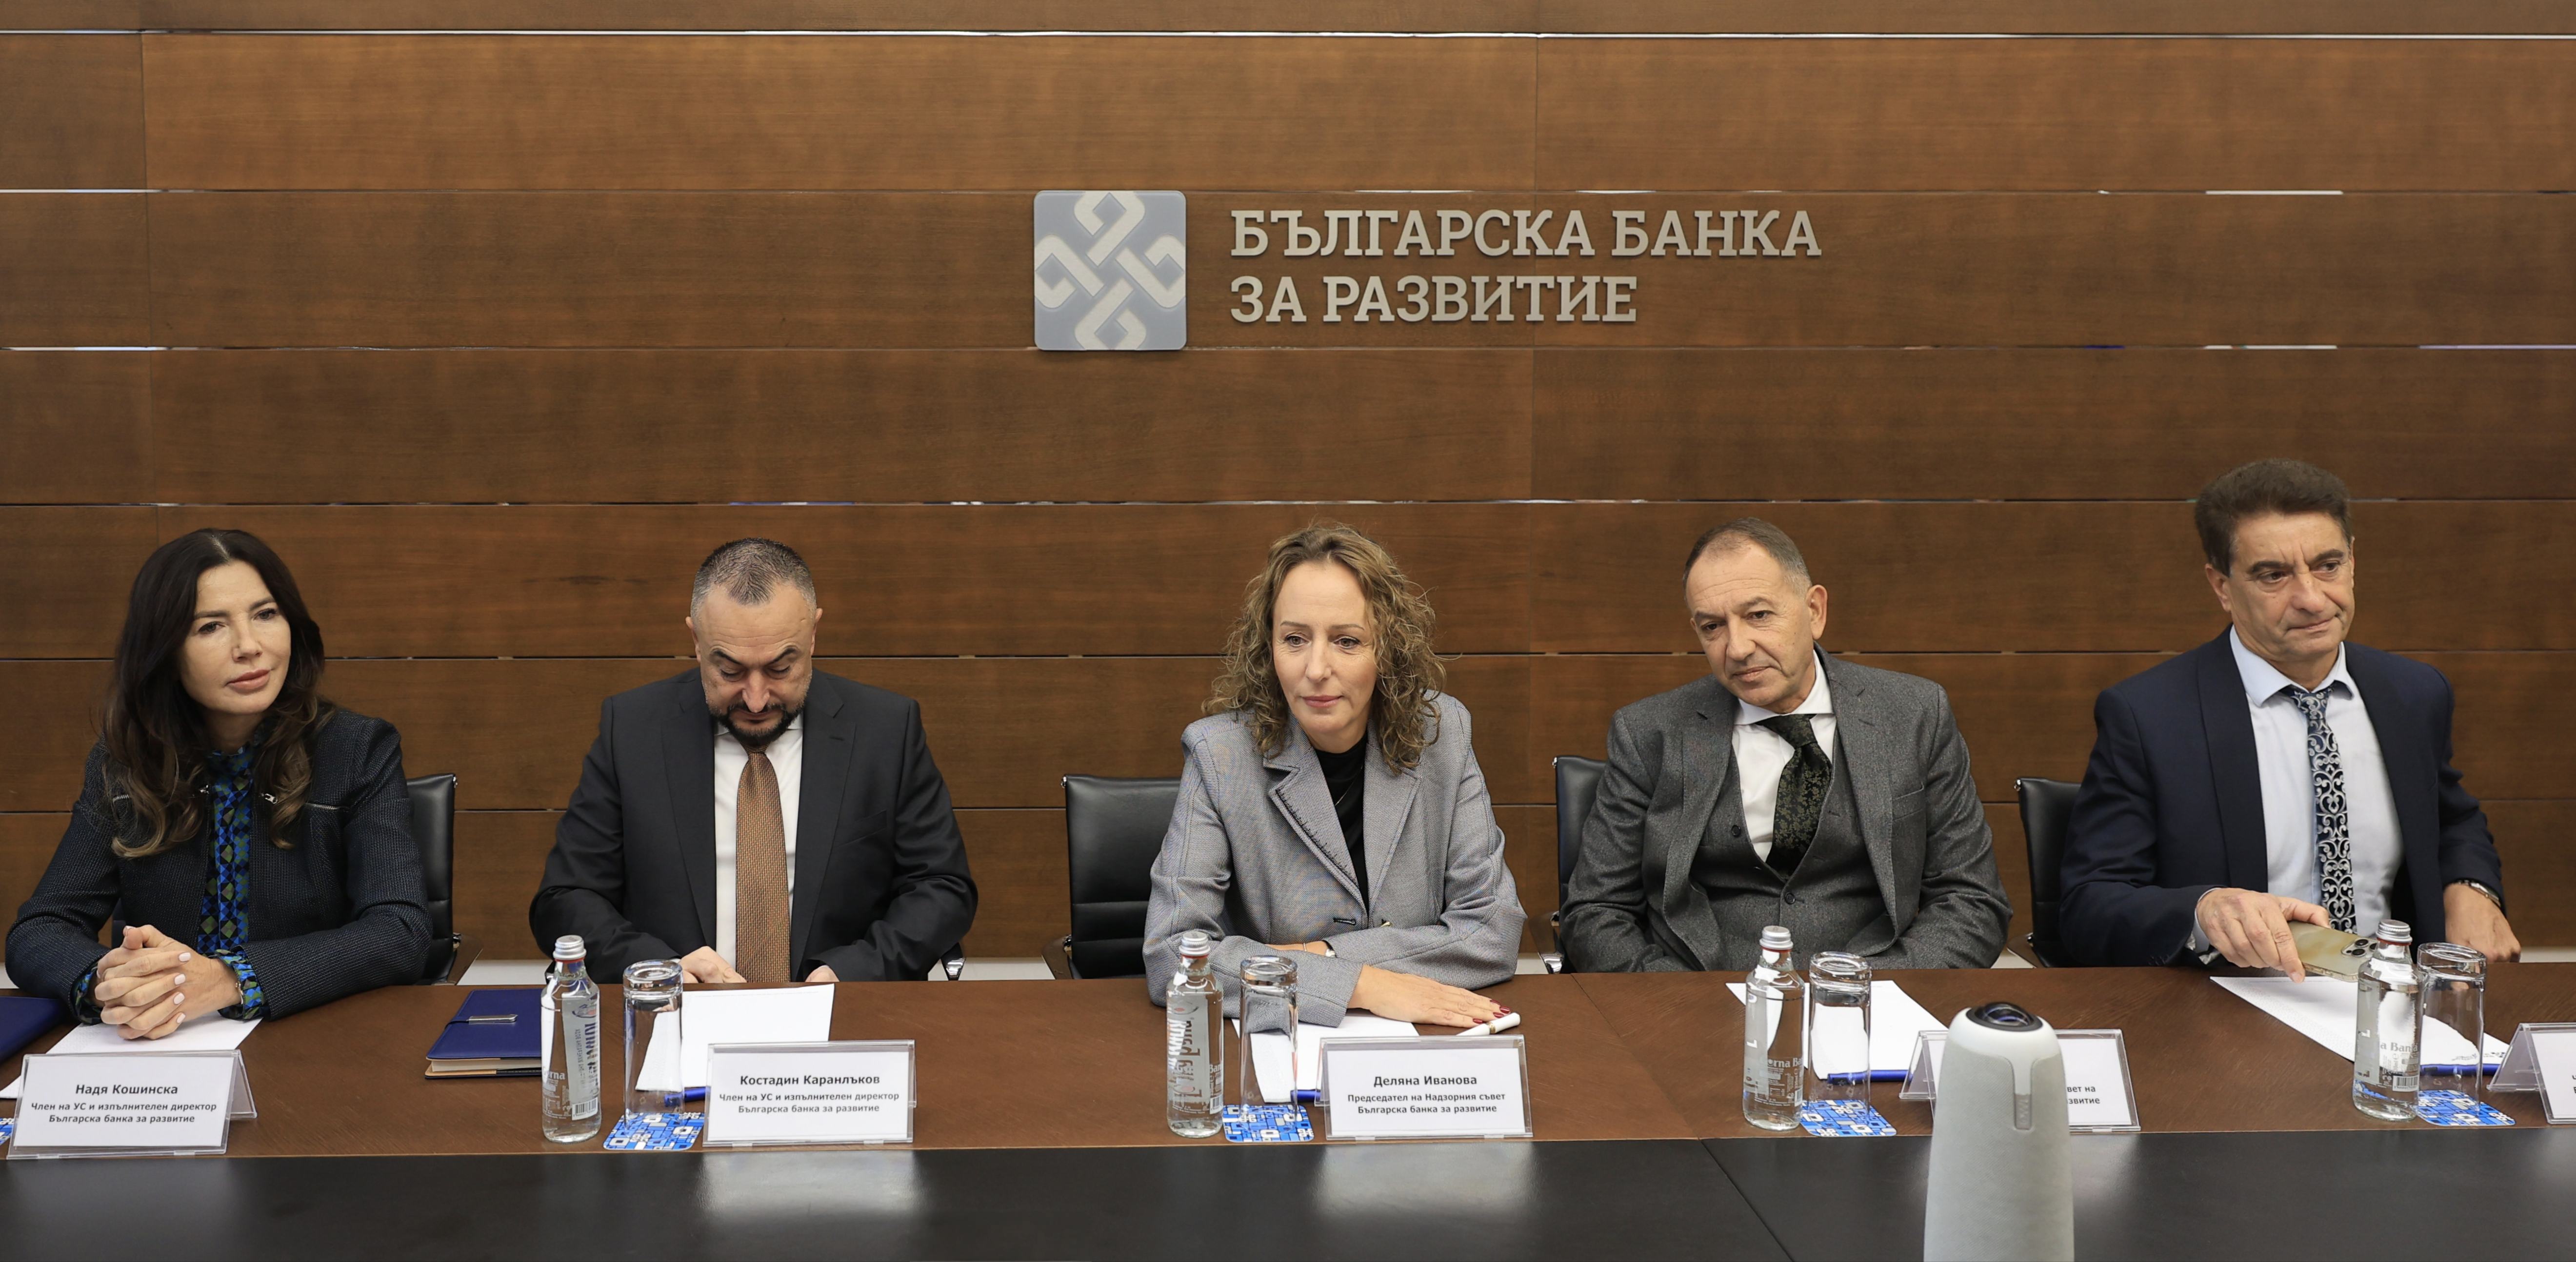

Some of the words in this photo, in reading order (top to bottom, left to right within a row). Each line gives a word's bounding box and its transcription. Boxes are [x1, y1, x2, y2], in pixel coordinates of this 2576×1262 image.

[1230, 209, 1596, 256] БЪЛГАРСКА
[1611, 210, 1822, 256] БАНКА
[1230, 275, 1307, 323] ЗА
[1322, 275, 1637, 322] РАЗВИТИЕ
[740, 1075, 799, 1087] Костадин
[803, 1075, 880, 1087] Каранлъков
[1373, 1076, 1420, 1088] Деляна
[1424, 1075, 1477, 1085] Иванова
[75, 1084, 108, 1096] Надя
[112, 1084, 178, 1095] Кошинска
[719, 1093, 743, 1102] Член
[760, 1093, 773, 1101] УС
[855, 1093, 899, 1102] директор
[1348, 1094, 1408, 1103] Председател
[1425, 1093, 1477, 1102] Надзорния
[31, 1103, 56, 1111] Член
[170, 1104, 217, 1112] директор
[739, 1105, 788, 1115] Българска
[791, 1104, 819, 1113] банка
[836, 1105, 879, 1114] развитие
[1358, 1106, 1407, 1115] Българска
[1410, 1105, 1438, 1113] банка
[1454, 1106, 1497, 1115] развитие
[49, 1115, 101, 1124] Българска
[104, 1114, 133, 1123] банка
